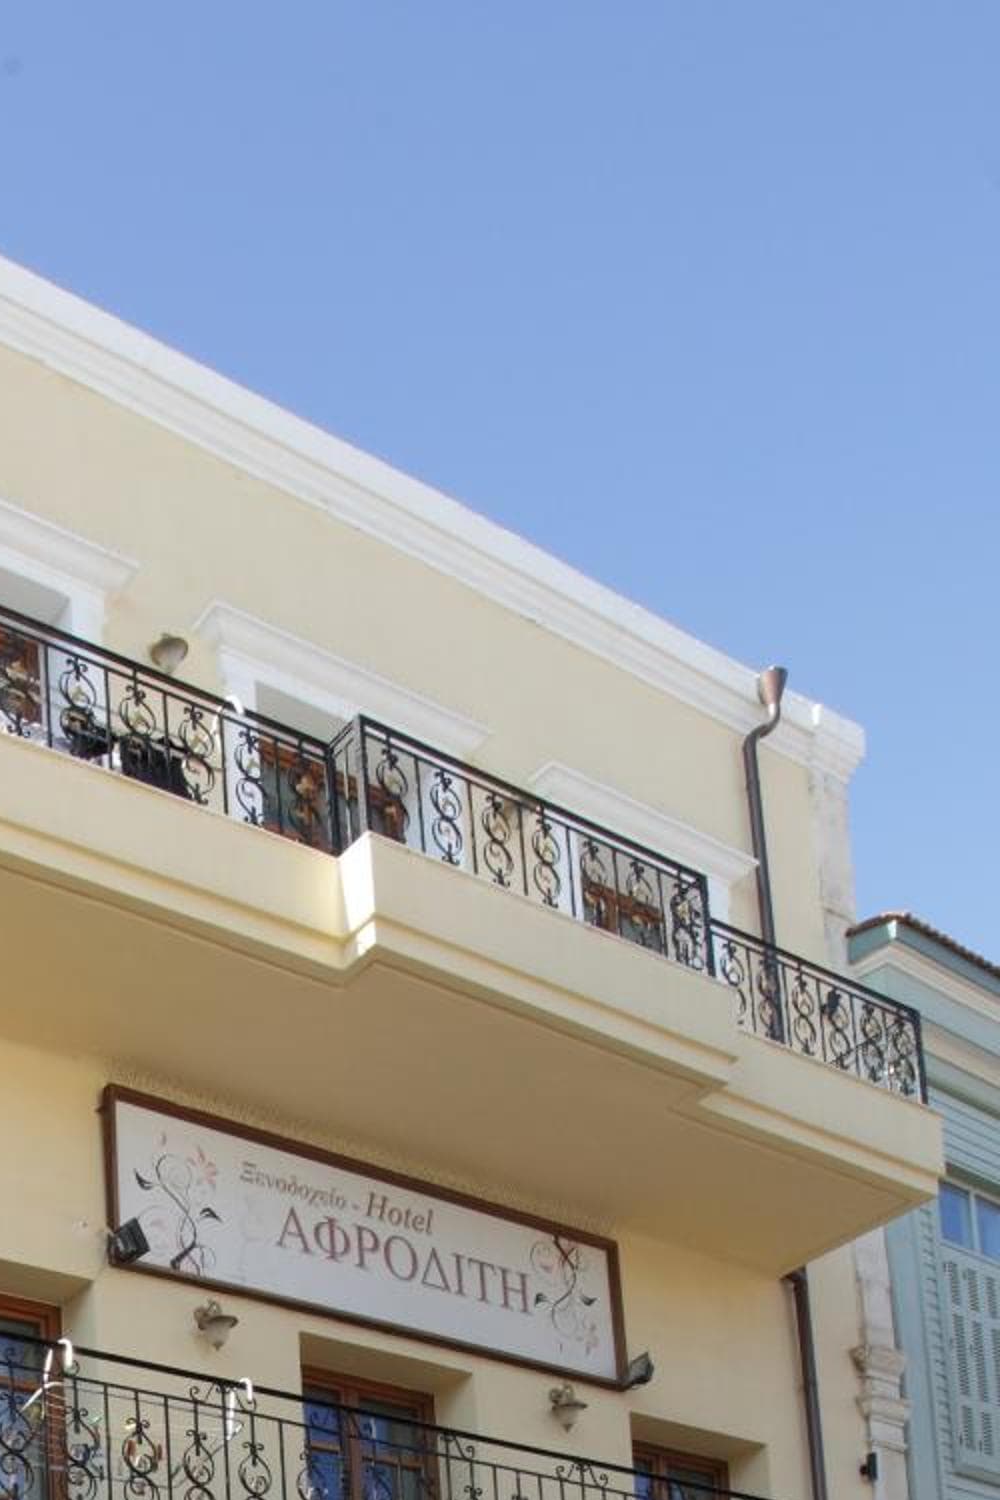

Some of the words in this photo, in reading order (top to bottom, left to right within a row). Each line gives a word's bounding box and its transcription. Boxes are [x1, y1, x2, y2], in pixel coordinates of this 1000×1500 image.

[239, 1160, 346, 1209] Ξενοδοχείο
[366, 1191, 434, 1236] Hotel
[275, 1206, 530, 1313] ΑΦΡΟΔΙΤΗ
